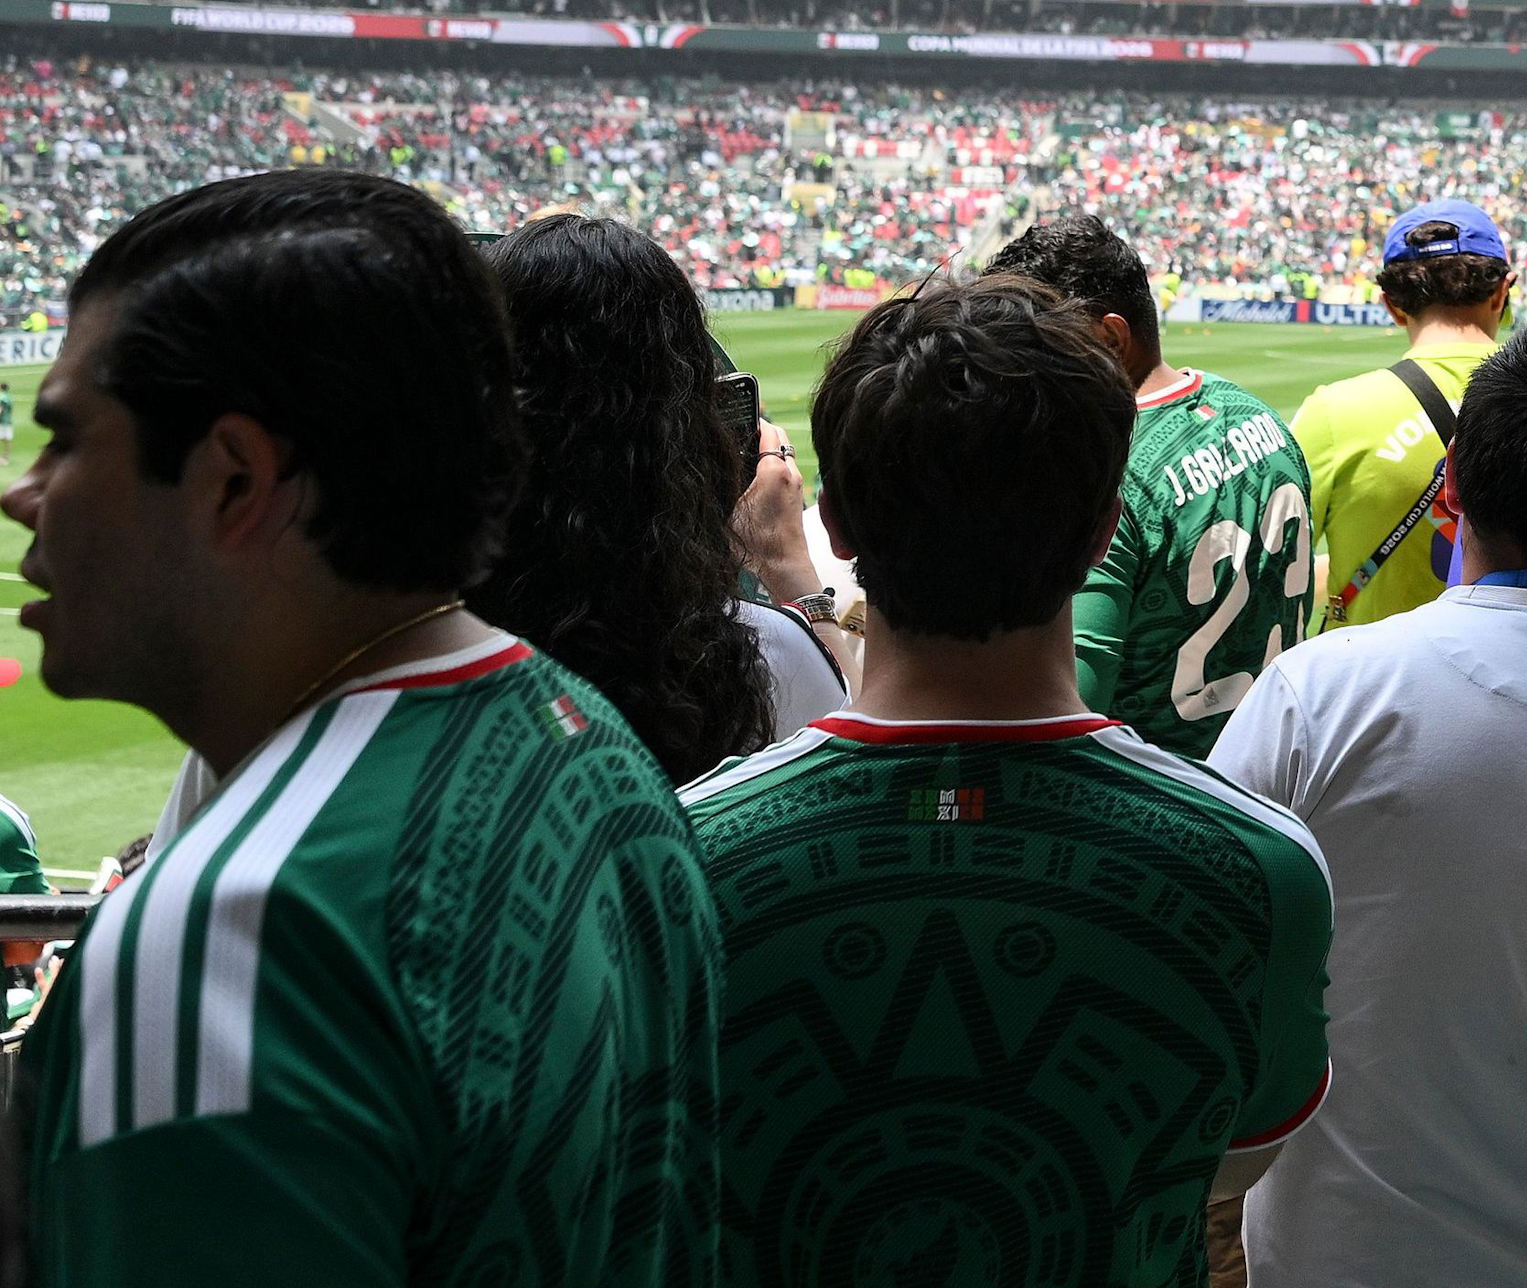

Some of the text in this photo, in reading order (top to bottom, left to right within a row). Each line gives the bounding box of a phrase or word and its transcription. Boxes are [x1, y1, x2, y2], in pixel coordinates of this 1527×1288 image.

[707, 290, 775, 310] exona
[1164, 411, 1292, 508] J.GALLARDO
[1381, 475, 1443, 555] WORLD CUP 2026
